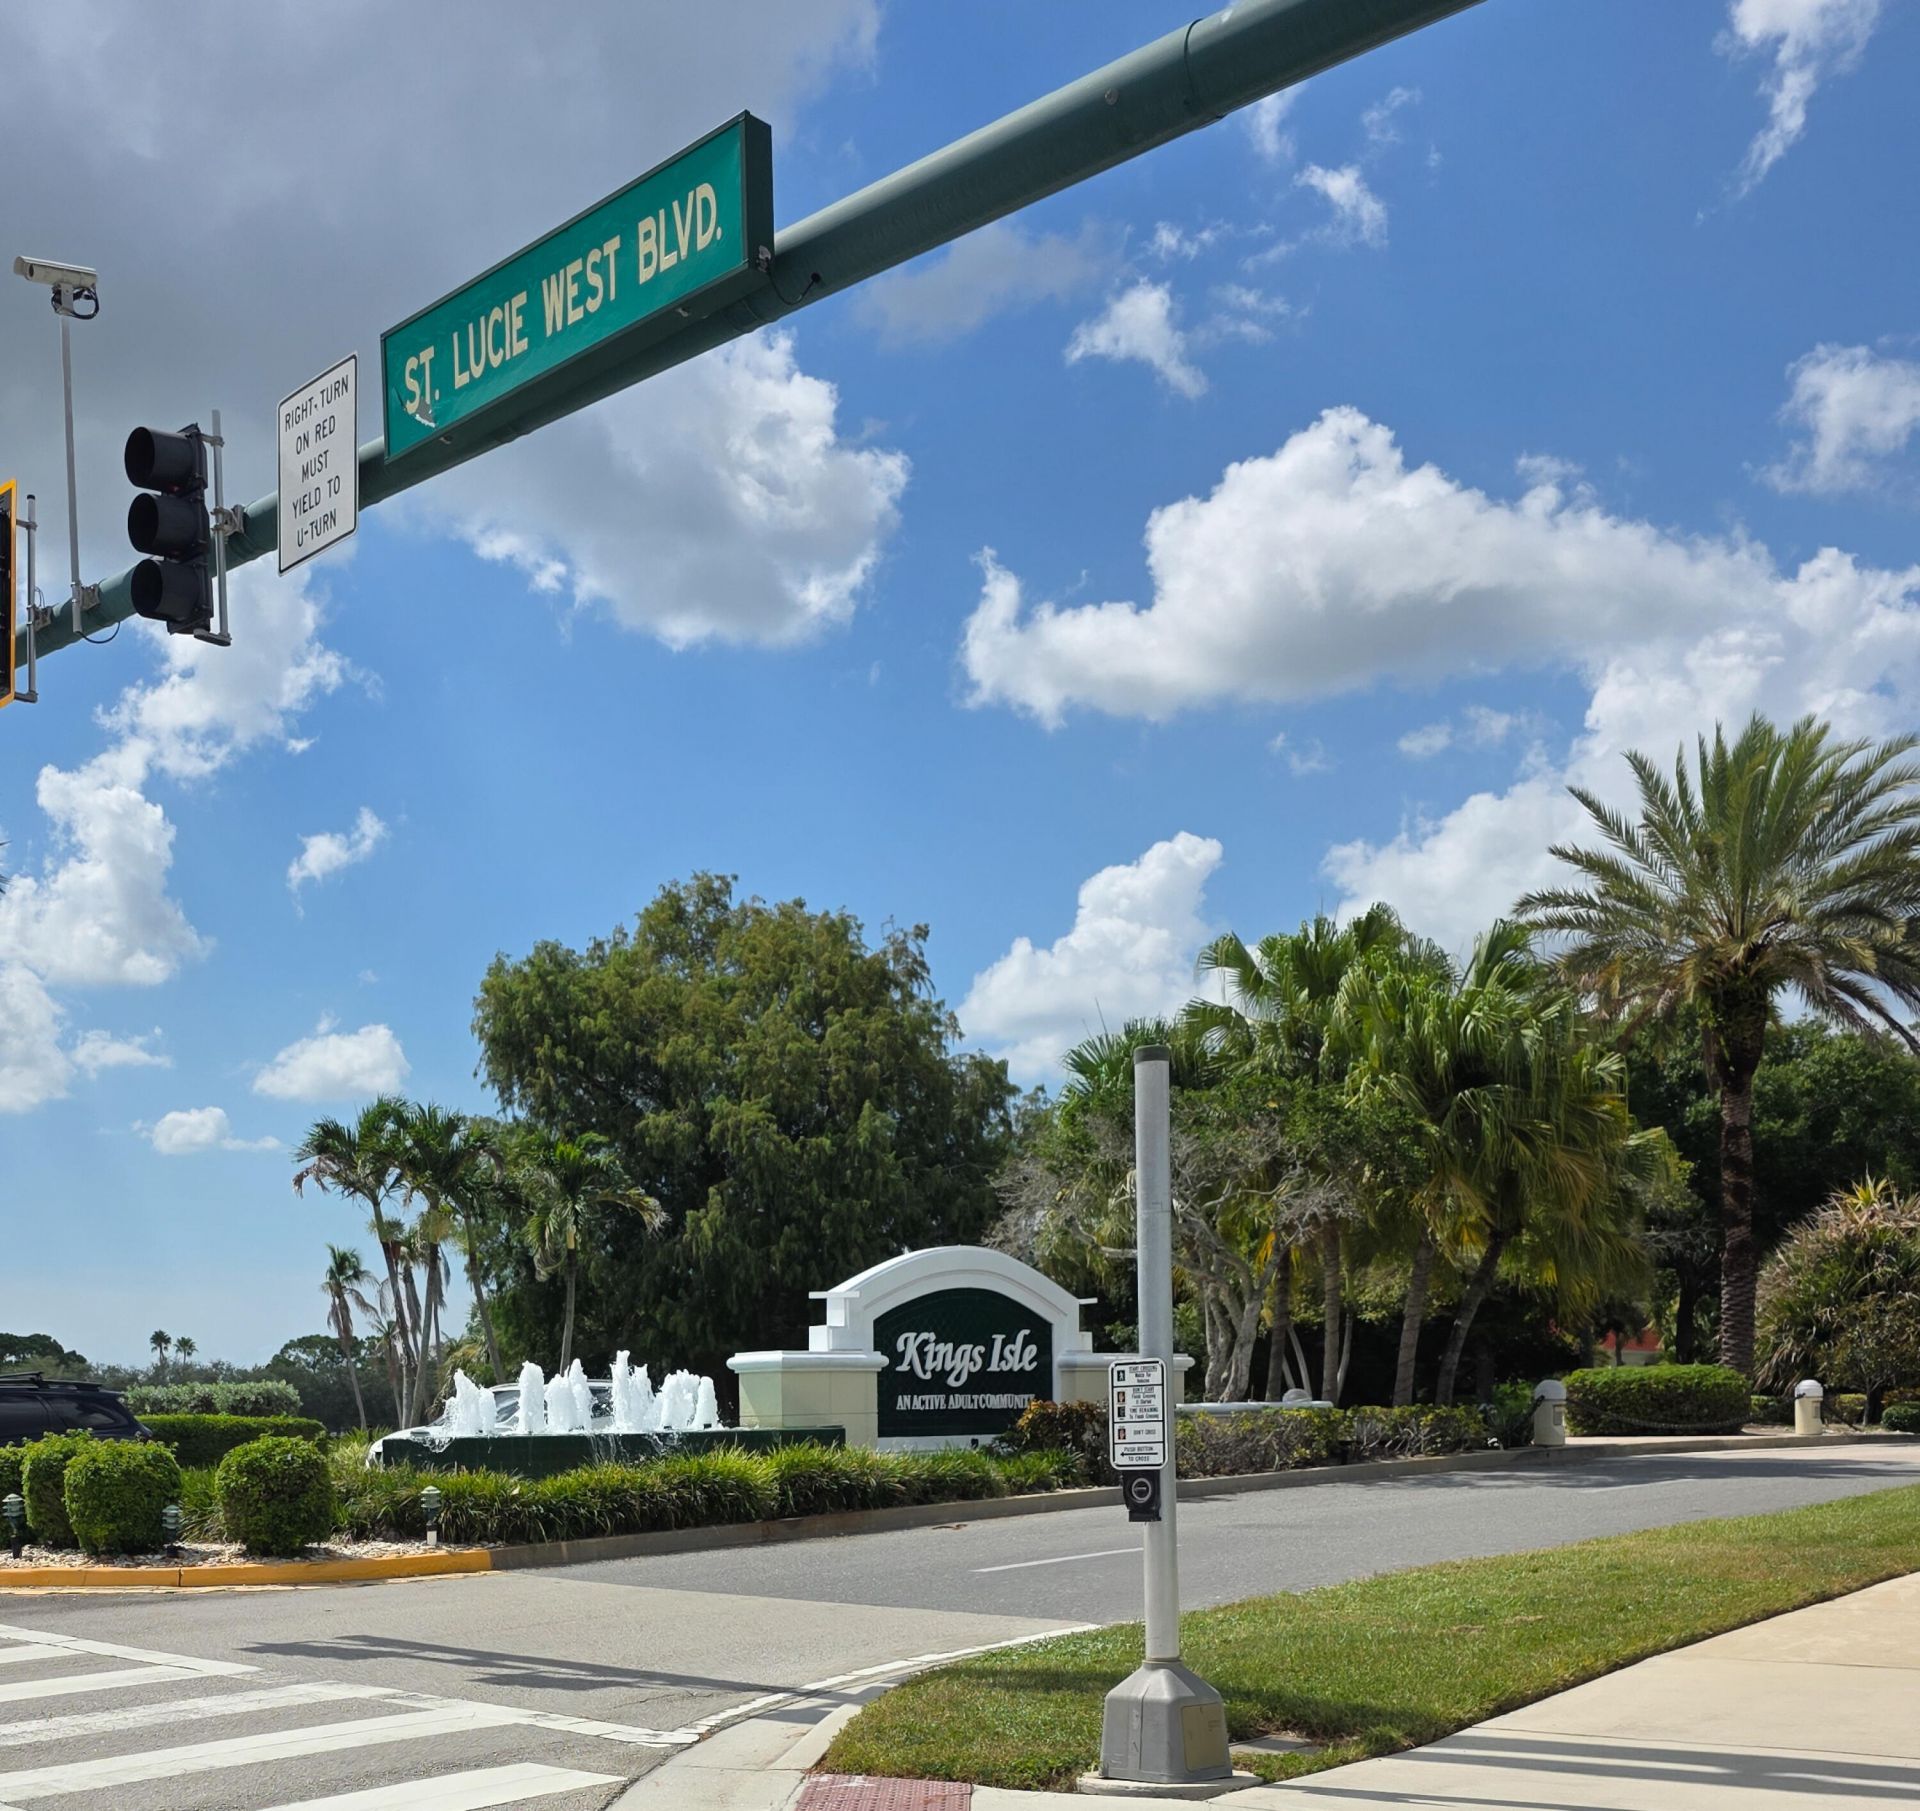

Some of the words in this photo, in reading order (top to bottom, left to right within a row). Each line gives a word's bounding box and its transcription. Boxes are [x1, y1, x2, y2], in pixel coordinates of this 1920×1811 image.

[404, 346, 440, 415] ST.
[453, 291, 528, 390] LUCIE
[542, 235, 621, 338] WEST
[638, 183, 722, 286] BLVD.
[285, 398, 314, 433] RIGHT
[320, 374, 349, 408] TURN
[296, 430, 310, 455] ON
[315, 415, 336, 444] RED
[301, 450, 329, 484] MUST
[292, 486, 321, 519] YIELD
[327, 475, 341, 499] TO
[297, 508, 337, 548] U-TURN
[895, 1332, 986, 1388] Kings
[986, 1329, 1038, 1372] Isle
[896, 1395, 911, 1410] AN
[912, 1394, 946, 1410] ACTIVE
[947, 1394, 979, 1409] ADULT
